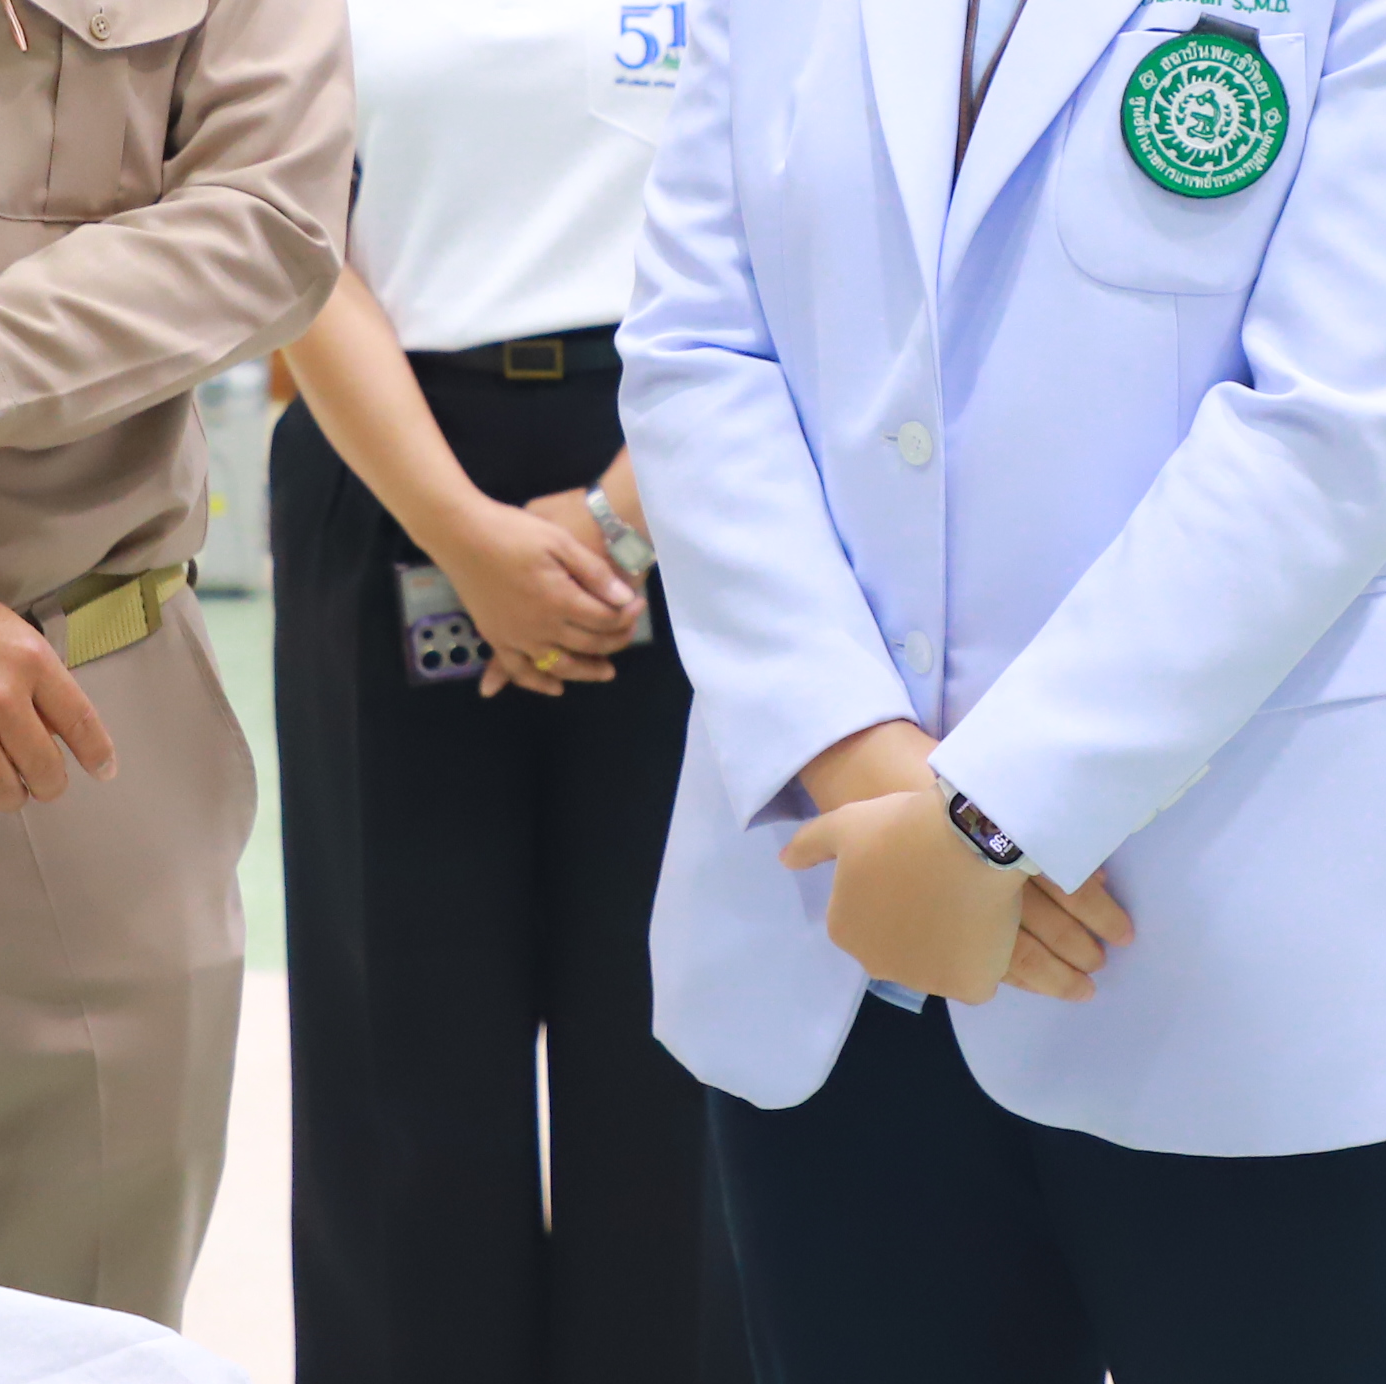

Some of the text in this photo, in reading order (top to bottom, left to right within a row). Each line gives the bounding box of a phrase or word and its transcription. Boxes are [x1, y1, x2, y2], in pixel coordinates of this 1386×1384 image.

[615, 1, 686, 69] 51
[1160, 41, 1272, 100] สถาบันพยาธิวิทยา
